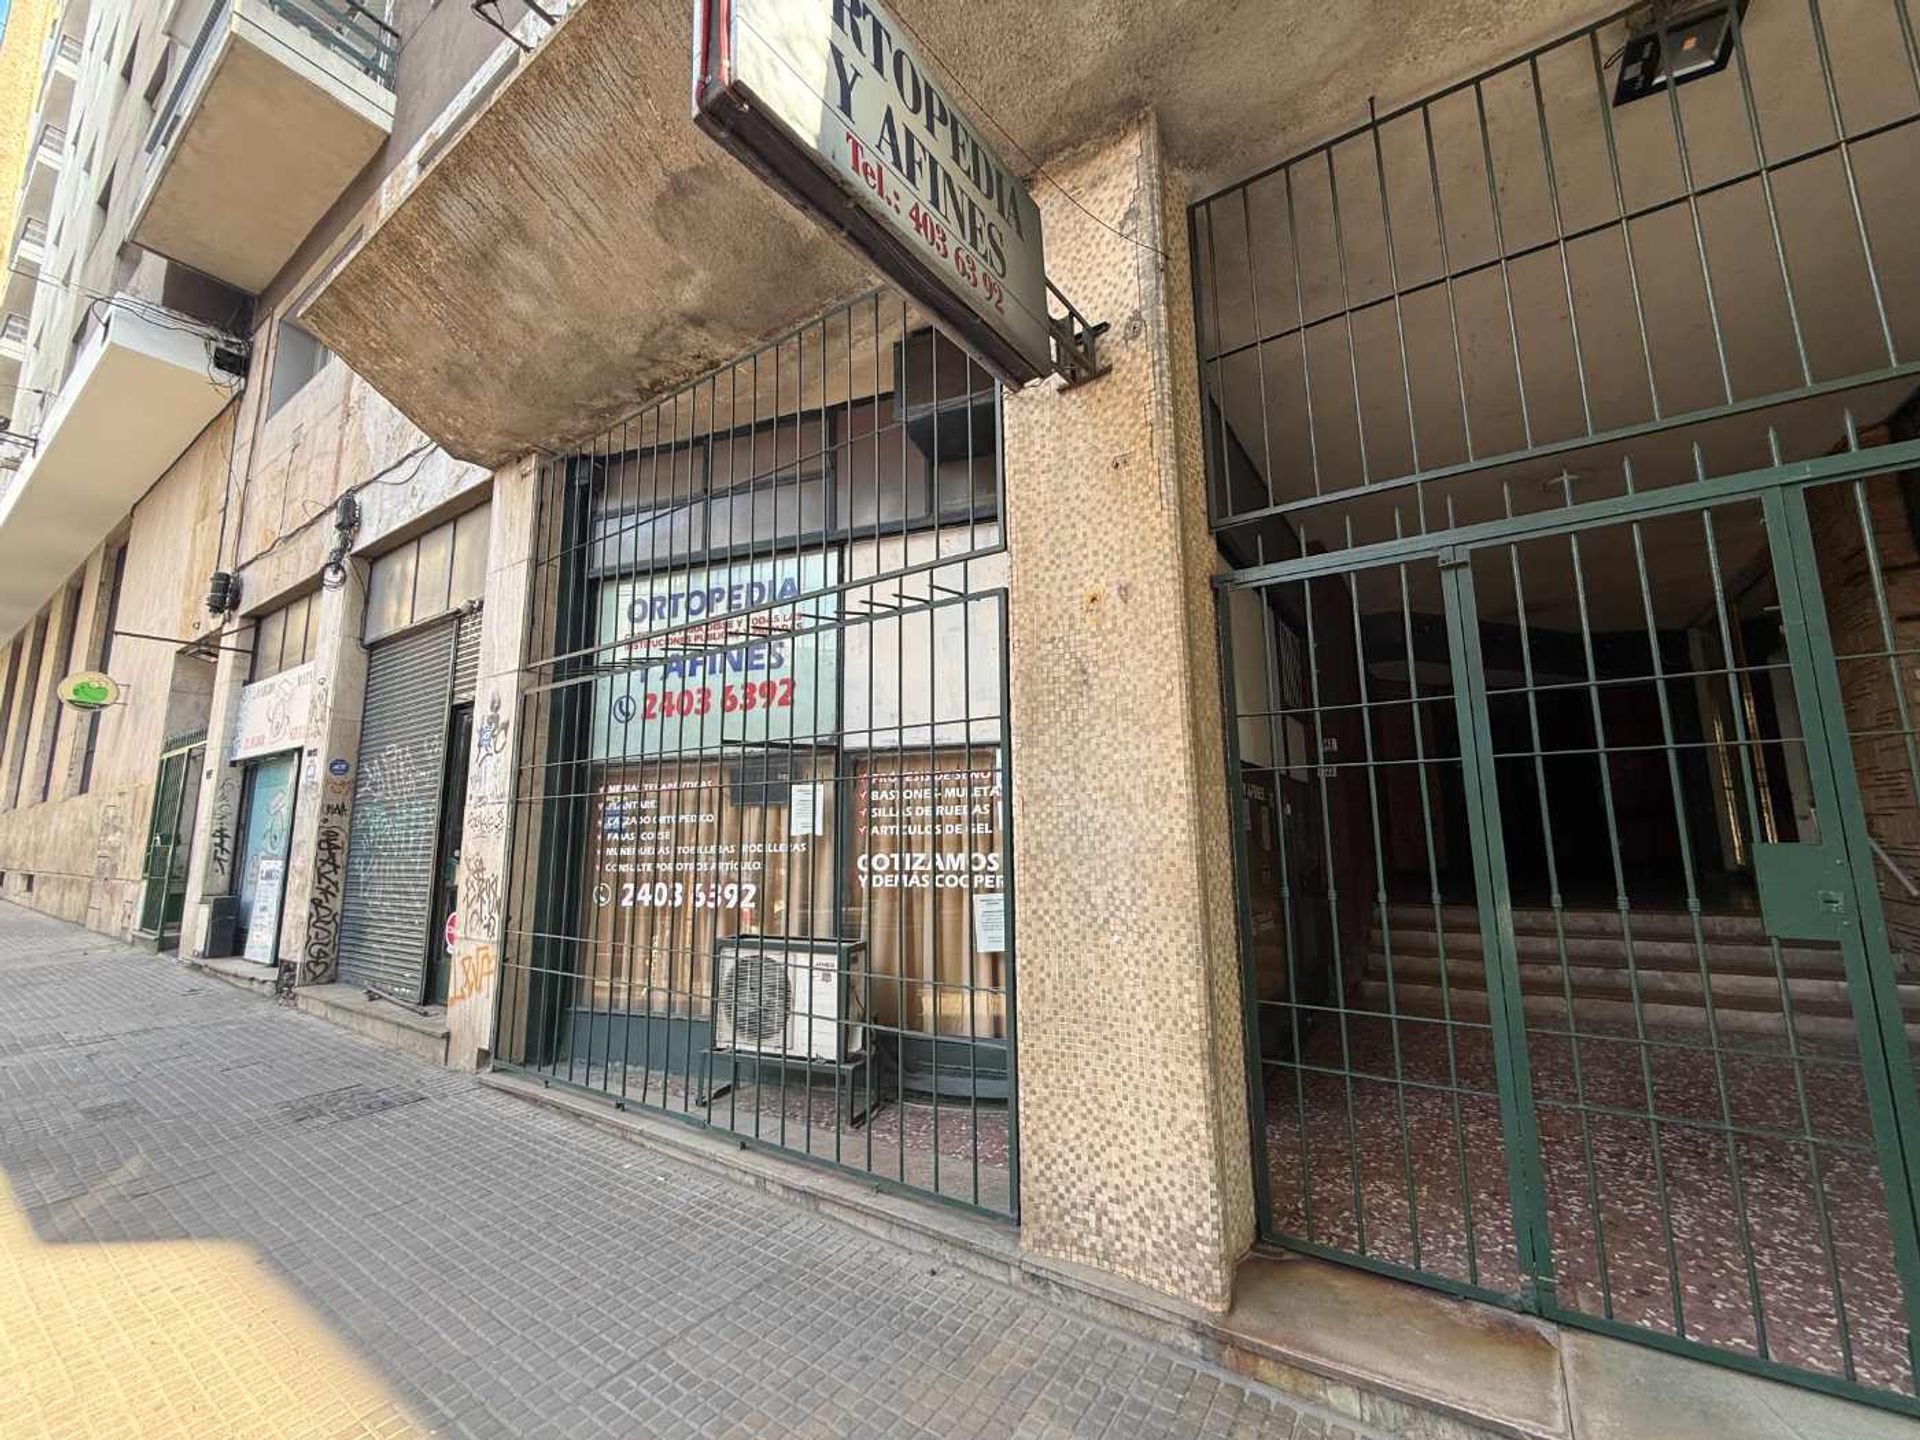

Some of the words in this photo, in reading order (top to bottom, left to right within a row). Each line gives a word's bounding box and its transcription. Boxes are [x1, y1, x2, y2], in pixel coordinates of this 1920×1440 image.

[829, 39, 863, 125] Y
[875, 104, 1007, 279] AFINES
[846, 130, 901, 215] Tel.:
[908, 201, 949, 259] 403
[954, 246, 978, 288] 63
[982, 271, 1005, 314] 92
[628, 577, 798, 624] ORTOPEDIA
[660, 641, 785, 681] AFINES
[641, 687, 712, 721] 2403
[721, 677, 796, 713] 6392
[944, 823, 961, 835] DE
[857, 852, 1000, 872] COTIZAMOS
[858, 874, 868, 888] Y
[621, 882, 683, 908] 2403
[694, 882, 757, 909] 6392
